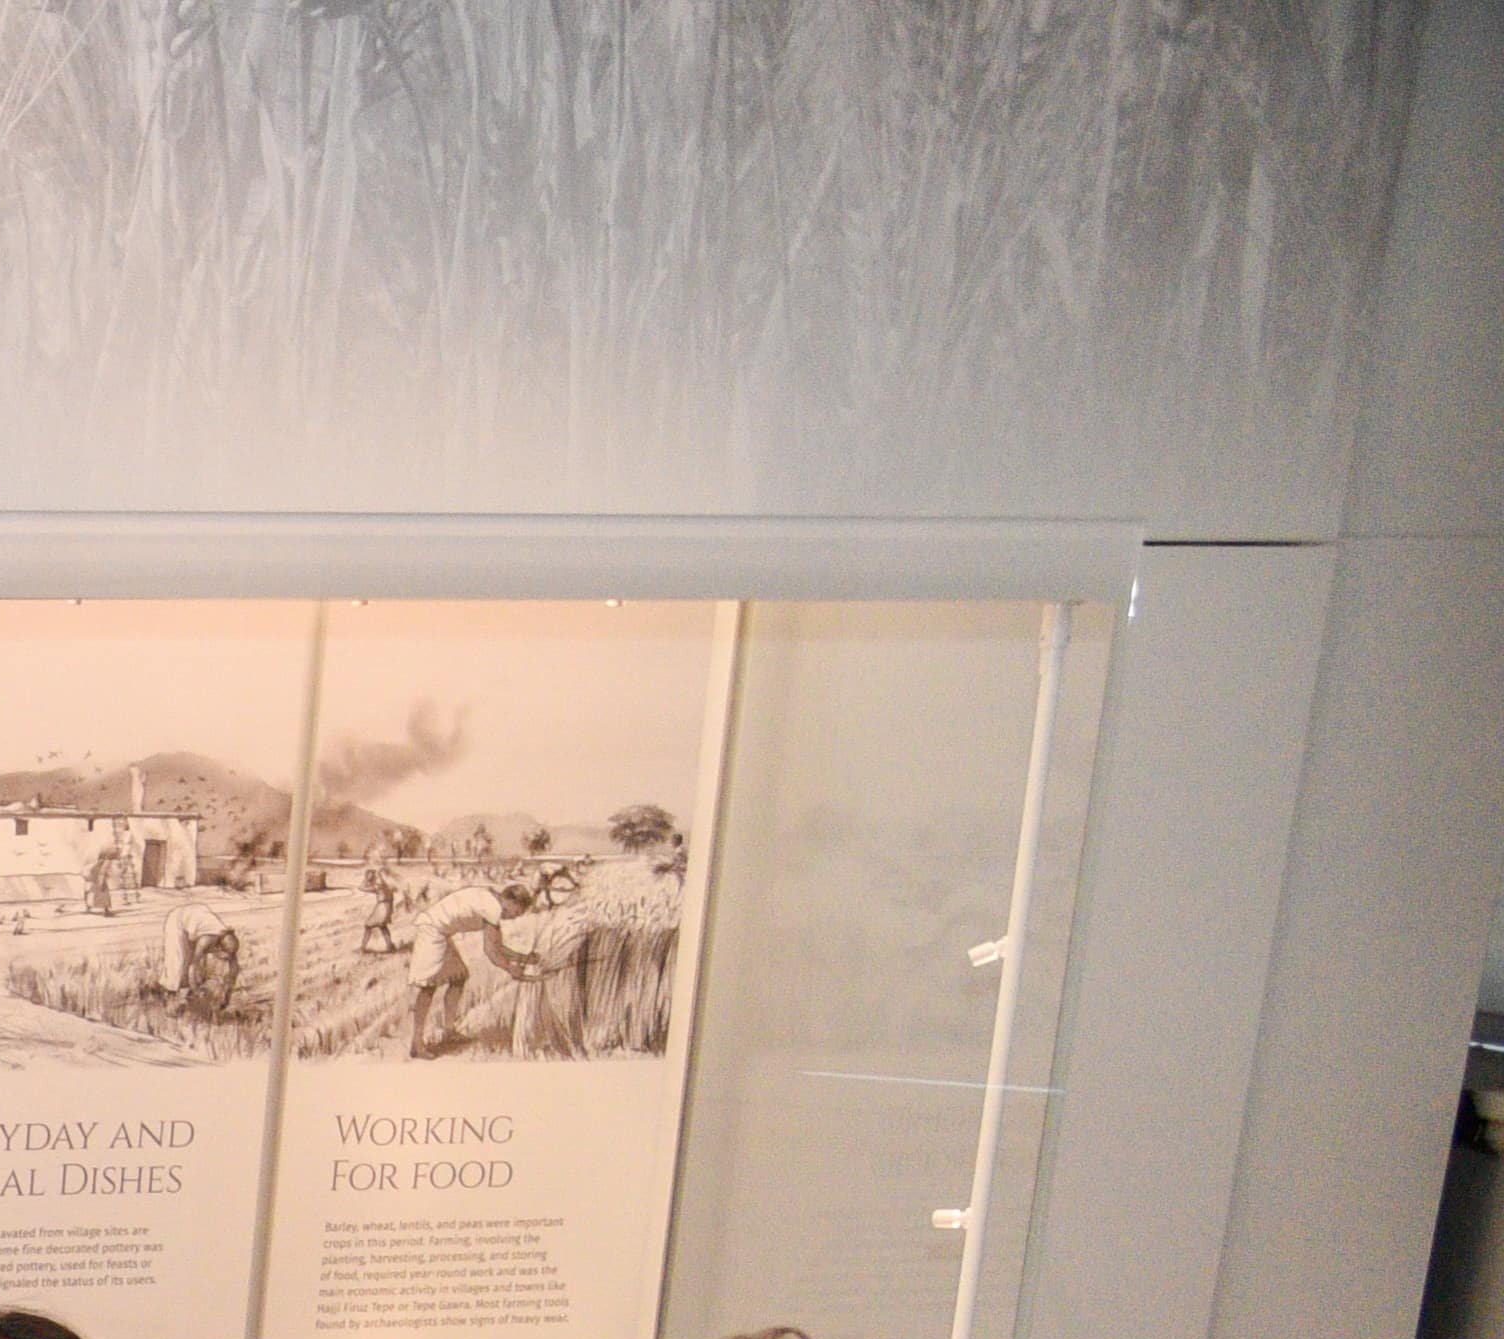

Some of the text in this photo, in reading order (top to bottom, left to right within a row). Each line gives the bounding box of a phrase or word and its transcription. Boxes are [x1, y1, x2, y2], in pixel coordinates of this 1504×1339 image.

[109, 1119, 195, 1149] AND
[336, 1114, 514, 1146] WORKING
[59, 1162, 183, 1196] DISHES
[331, 1159, 514, 1191] FOR FOOD
[39, 1227, 63, 1237] from
[67, 1226, 101, 1239] village
[104, 1227, 128, 1236] sites
[131, 1227, 149, 1235] are
[22, 1243, 42, 1254] fine
[45, 1243, 99, 1254] decorated
[101, 1243, 140, 1254] pottery
[143, 1243, 163, 1251] was
